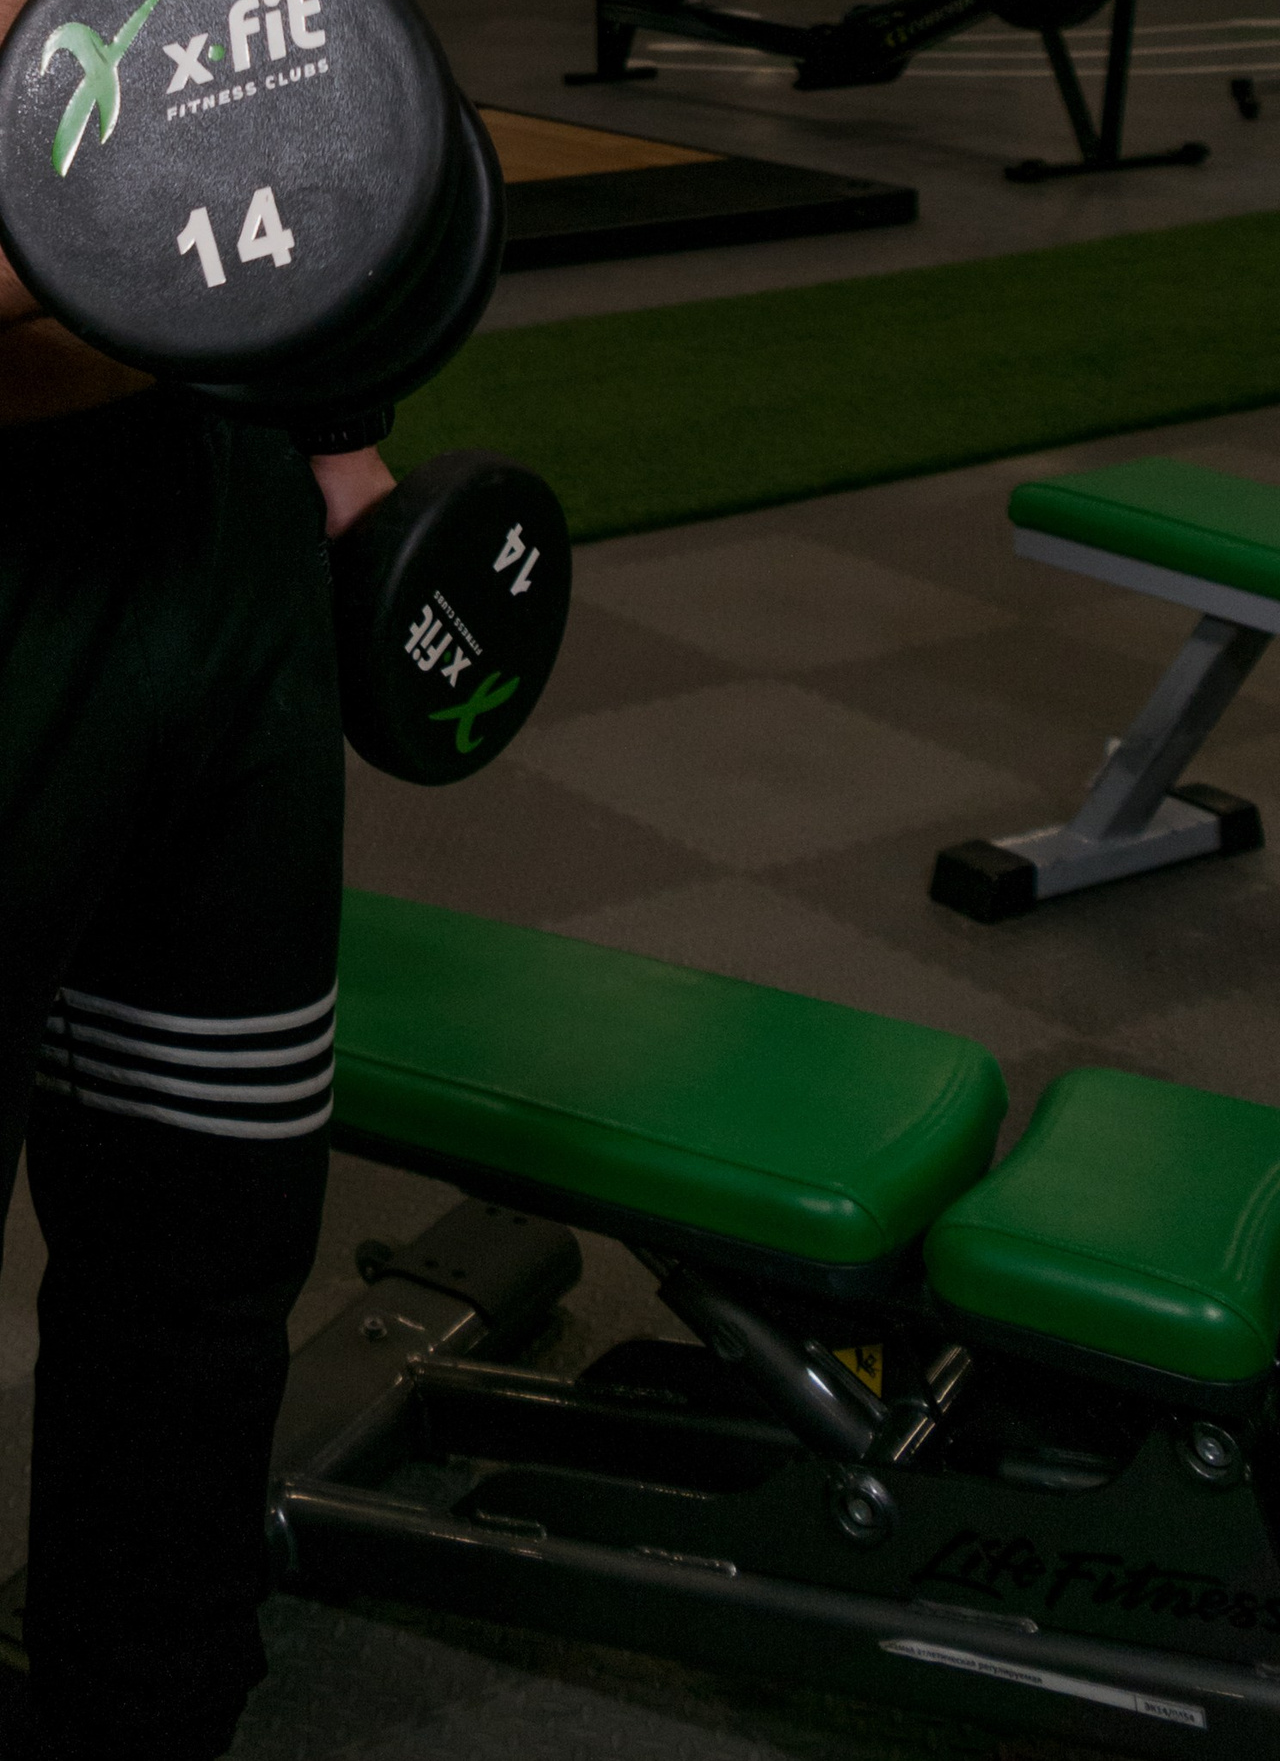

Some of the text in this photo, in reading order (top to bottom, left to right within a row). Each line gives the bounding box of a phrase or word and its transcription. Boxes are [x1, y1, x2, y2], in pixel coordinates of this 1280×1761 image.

[166, 58, 330, 122] FITNESS CLUBS
[176, 186, 296, 288] 14
[493, 523, 540, 596] 14
[433, 590, 483, 656] FITNESS CLUBS
